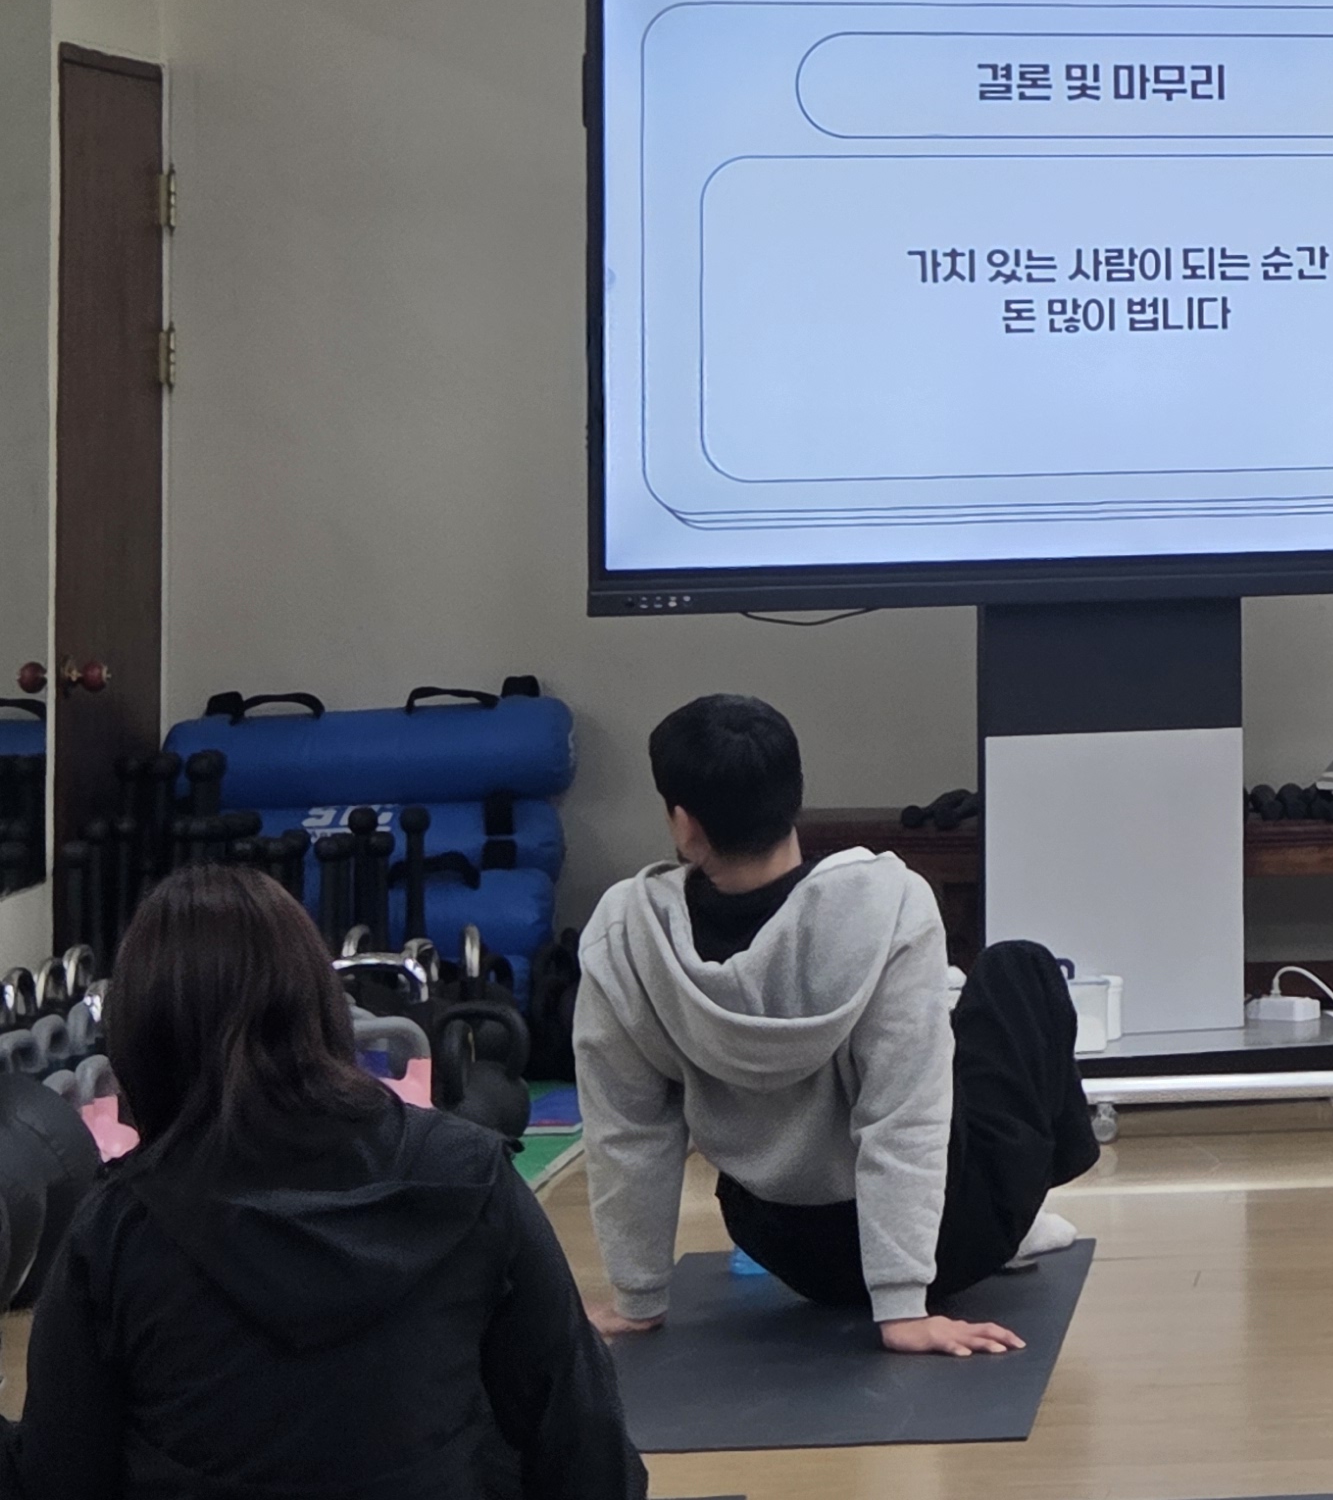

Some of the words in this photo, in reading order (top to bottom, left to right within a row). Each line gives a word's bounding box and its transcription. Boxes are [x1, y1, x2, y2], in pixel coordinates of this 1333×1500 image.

[976, 63, 1053, 101] 결론
[1065, 63, 1101, 101] 및
[1113, 63, 1226, 102] 마무리
[906, 247, 976, 284] 가치
[986, 248, 1058, 285] 있는
[1068, 247, 1172, 283] 사람이
[1181, 246, 1251, 281] 되는
[1260, 245, 1330, 282] 순간
[1001, 299, 1037, 334] 돈
[1047, 297, 1116, 334] 많이
[1127, 296, 1232, 332] 법니다
